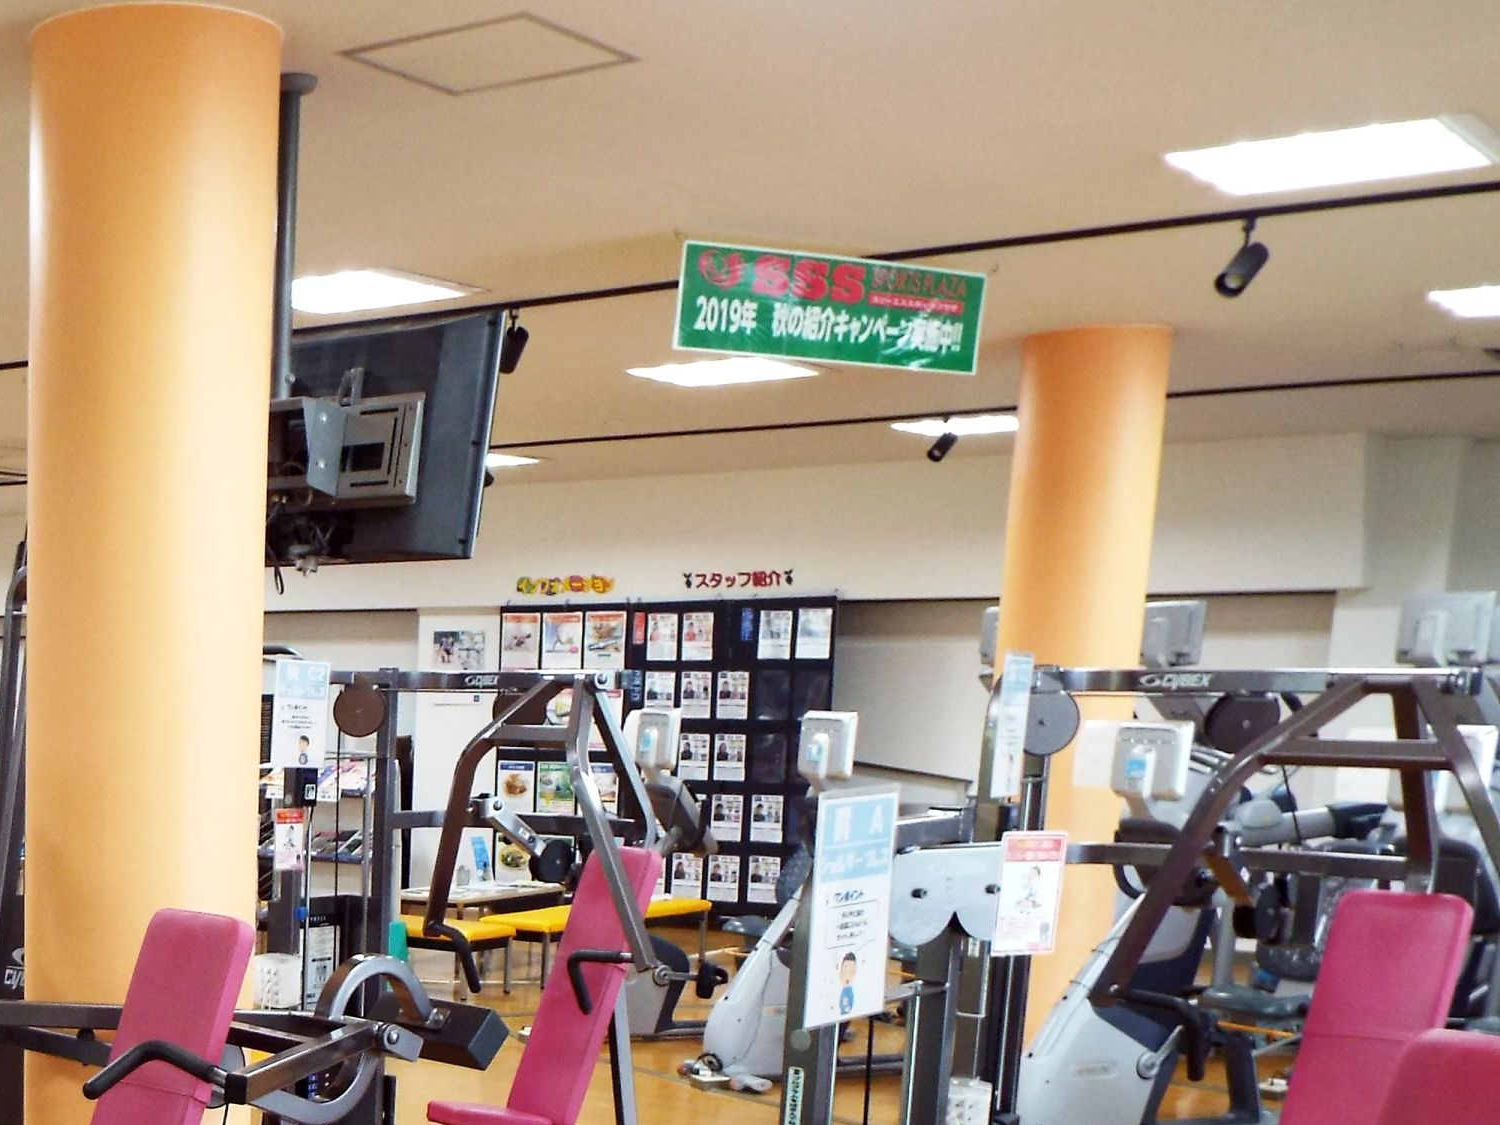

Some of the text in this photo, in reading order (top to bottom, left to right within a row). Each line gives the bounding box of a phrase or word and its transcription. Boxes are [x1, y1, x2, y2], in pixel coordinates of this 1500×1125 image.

[753, 255, 867, 305] SSS
[693, 295, 759, 335] 2019年
[694, 569, 782, 588] スタッフ紹介
[869, 804, 885, 835] A
